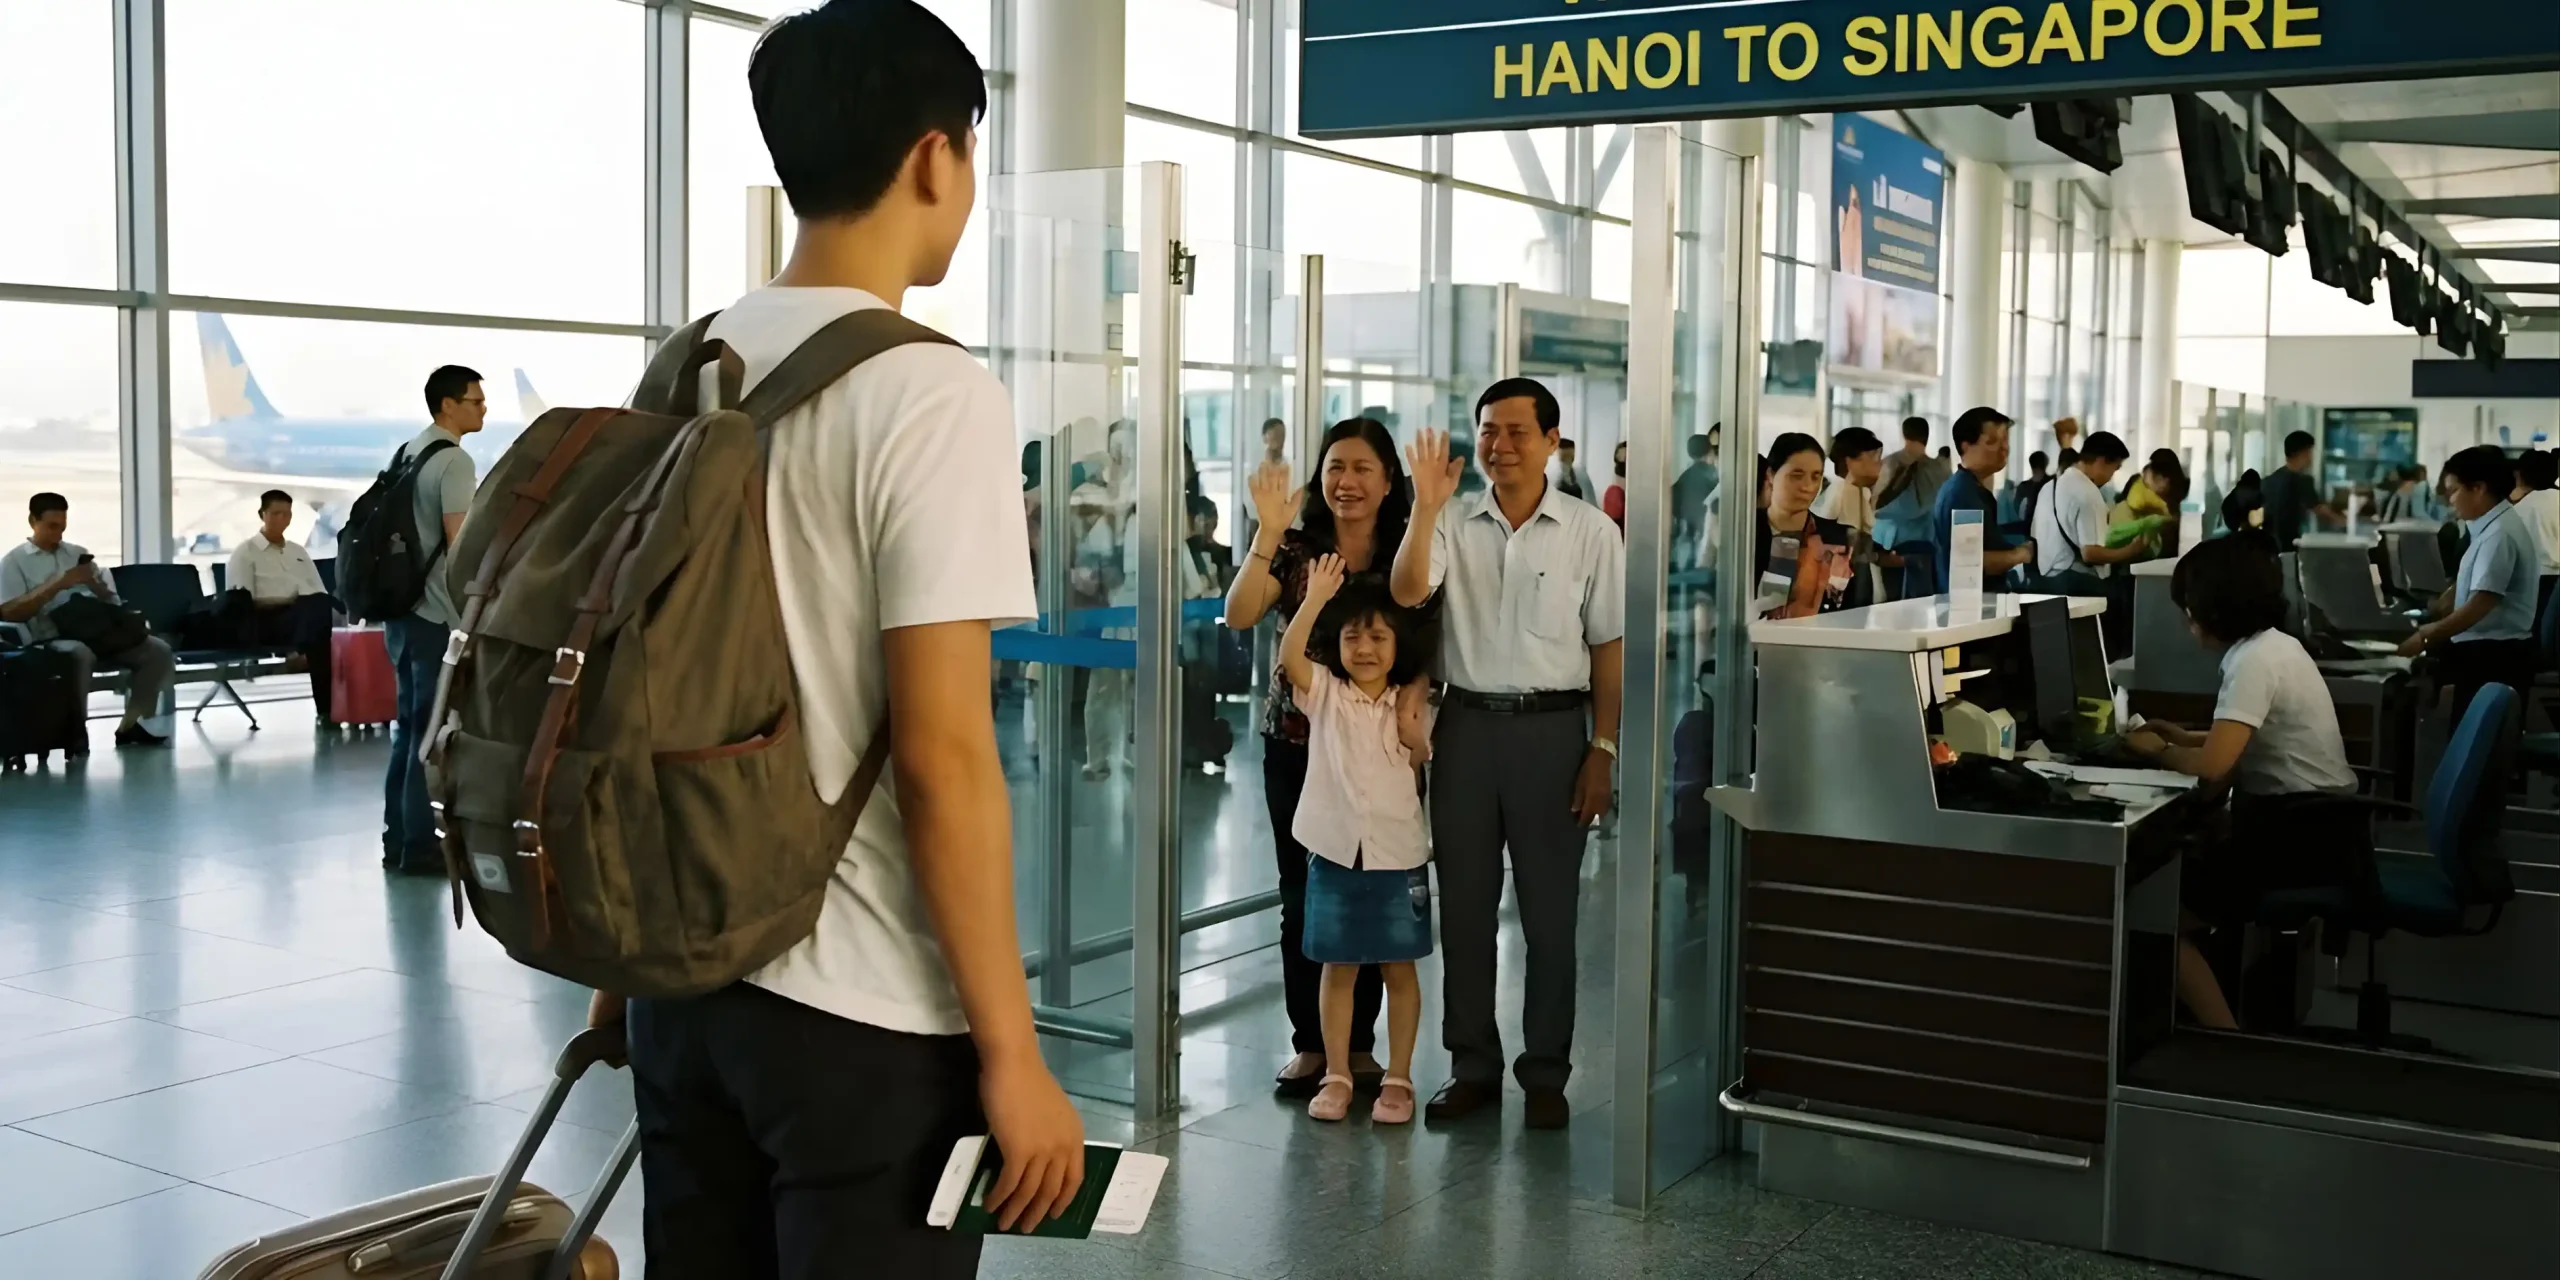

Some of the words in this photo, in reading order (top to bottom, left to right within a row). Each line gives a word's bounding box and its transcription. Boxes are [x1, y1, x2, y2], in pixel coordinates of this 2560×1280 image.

[1493, 30, 1702, 99] HANOI
[1723, 21, 1820, 83] TO
[1842, 0, 2323, 77] SINGAPORE
